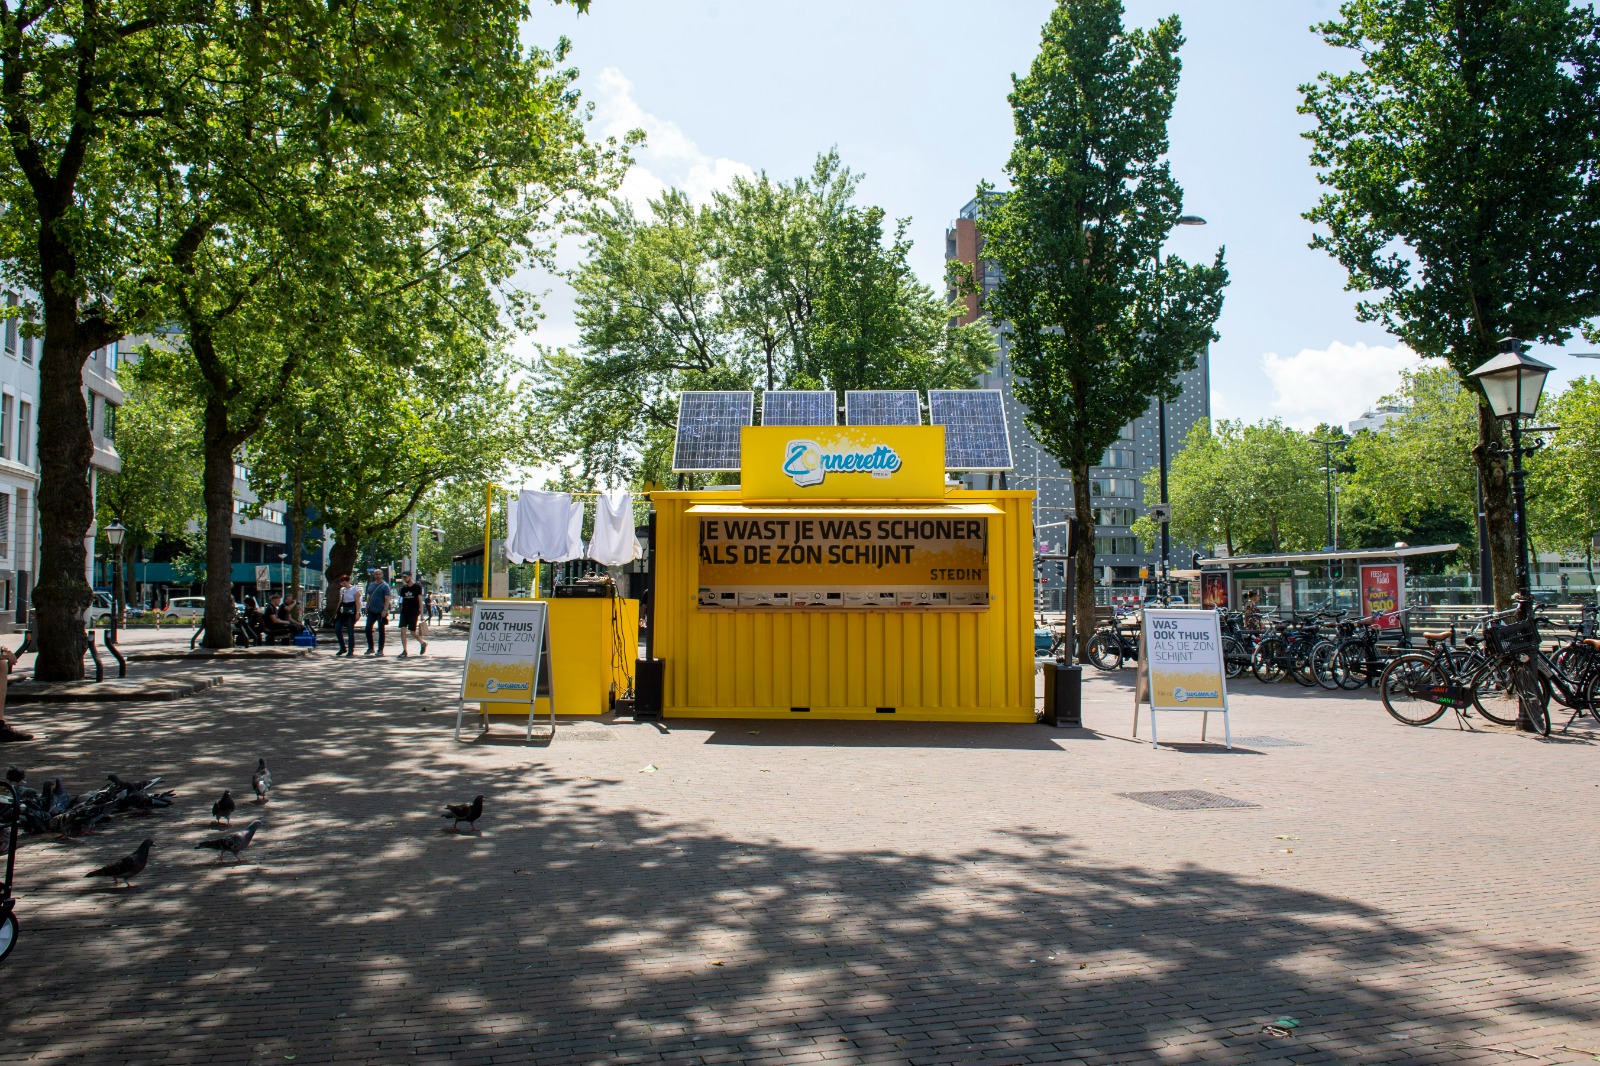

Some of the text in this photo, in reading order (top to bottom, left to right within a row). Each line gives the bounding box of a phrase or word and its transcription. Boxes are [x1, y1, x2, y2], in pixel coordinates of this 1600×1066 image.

[783, 444, 900, 475] Zonnerette
[724, 520, 790, 540] WAST
[794, 520, 814, 544] JE
[819, 520, 872, 540] WAS
[877, 520, 982, 540] SCHONER
[701, 545, 915, 569] ALS DE ZON SCHIJNT
[930, 568, 982, 580] STEDIN
[1368, 600, 1394, 612] 1500
[480, 612, 504, 620] WAS
[478, 621, 533, 632] OOK THUIS
[1152, 620, 1178, 630] WAS
[476, 632, 536, 642] ALS DE ZON
[1153, 630, 1210, 641] OOK THUIS
[475, 642, 514, 653] SCHIJNT
[1154, 641, 1214, 651] ALS DE ZON
[1155, 652, 1194, 662] SCHIJNT
